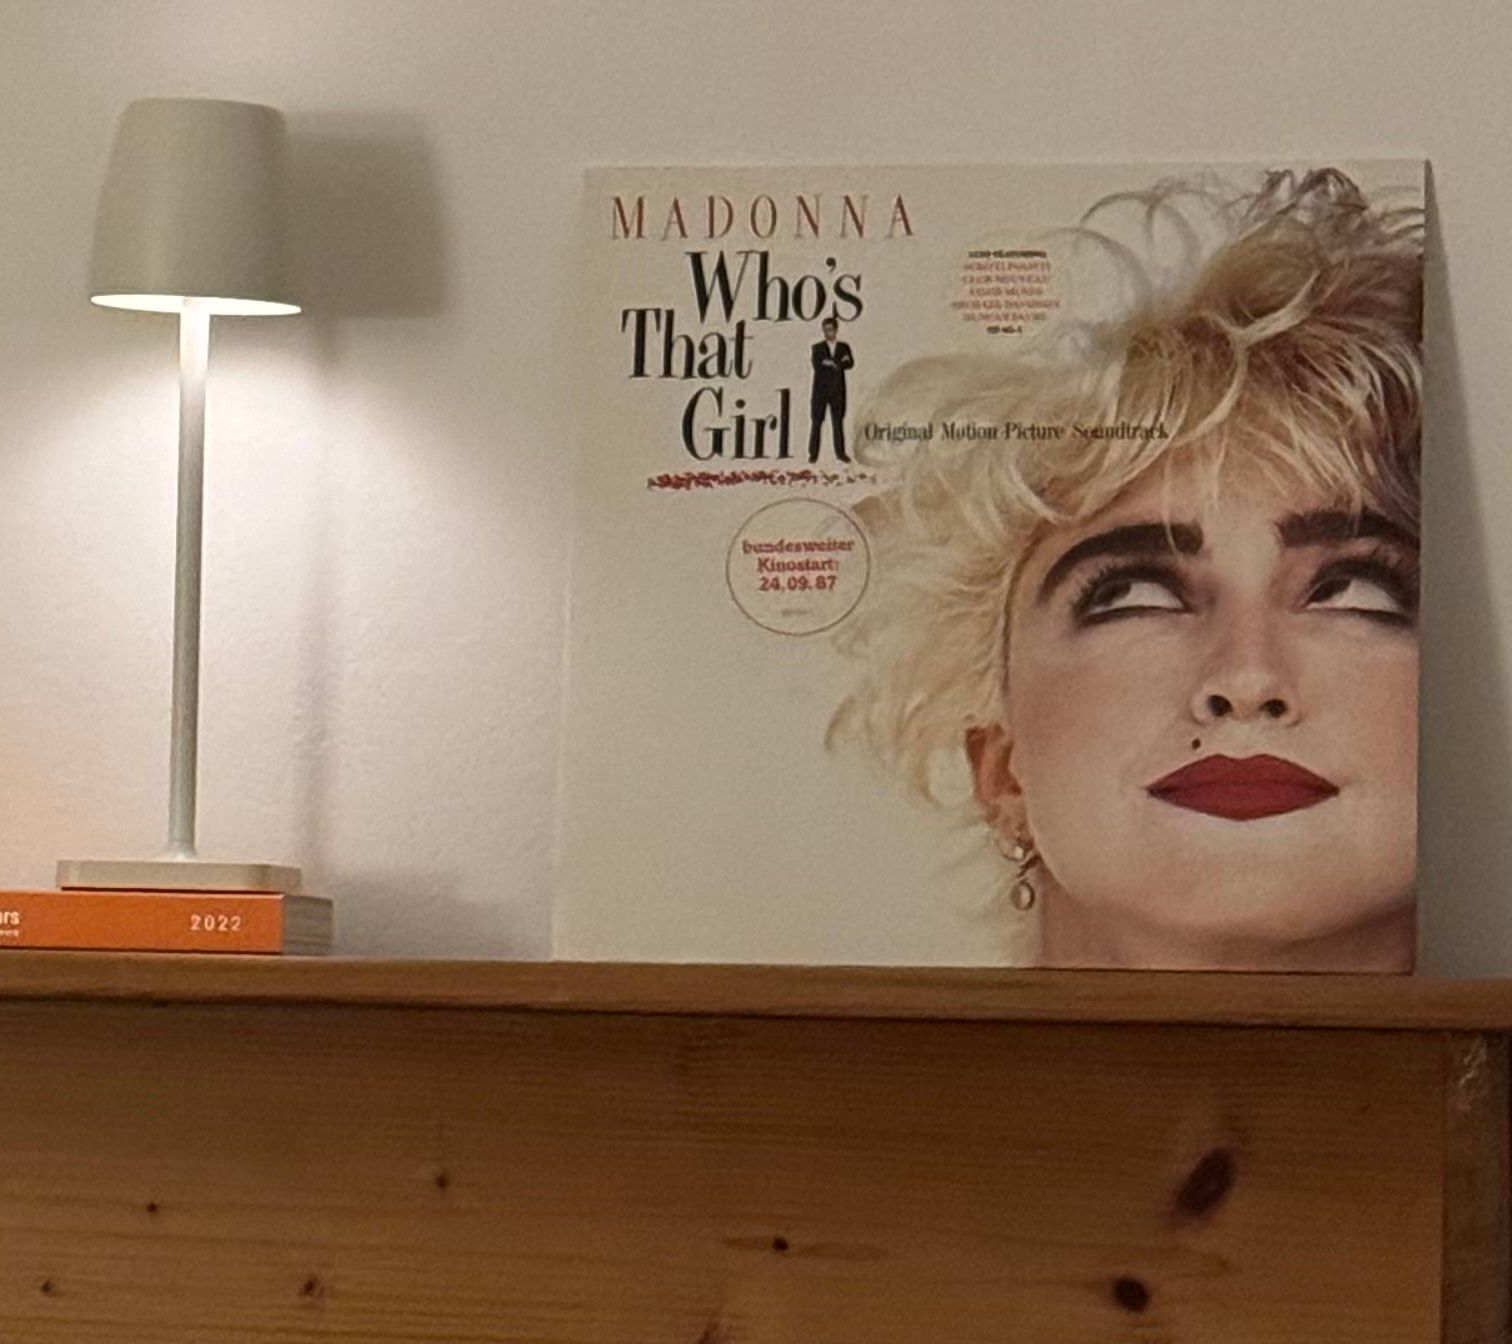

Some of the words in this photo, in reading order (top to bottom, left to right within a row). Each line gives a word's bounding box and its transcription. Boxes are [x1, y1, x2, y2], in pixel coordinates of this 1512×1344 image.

[611, 193, 915, 241] MADONNA
[685, 249, 864, 323] Who's
[620, 307, 756, 380] That
[681, 385, 795, 461] Girl
[864, 421, 934, 442] Original
[941, 421, 998, 440] Motion
[1003, 421, 1064, 440] Picture
[1071, 421, 1170, 440] Soundtrack
[742, 538, 855, 554] bundesweiter
[759, 575, 837, 592] 24.09.87
[190, 914, 241, 932] 2022
